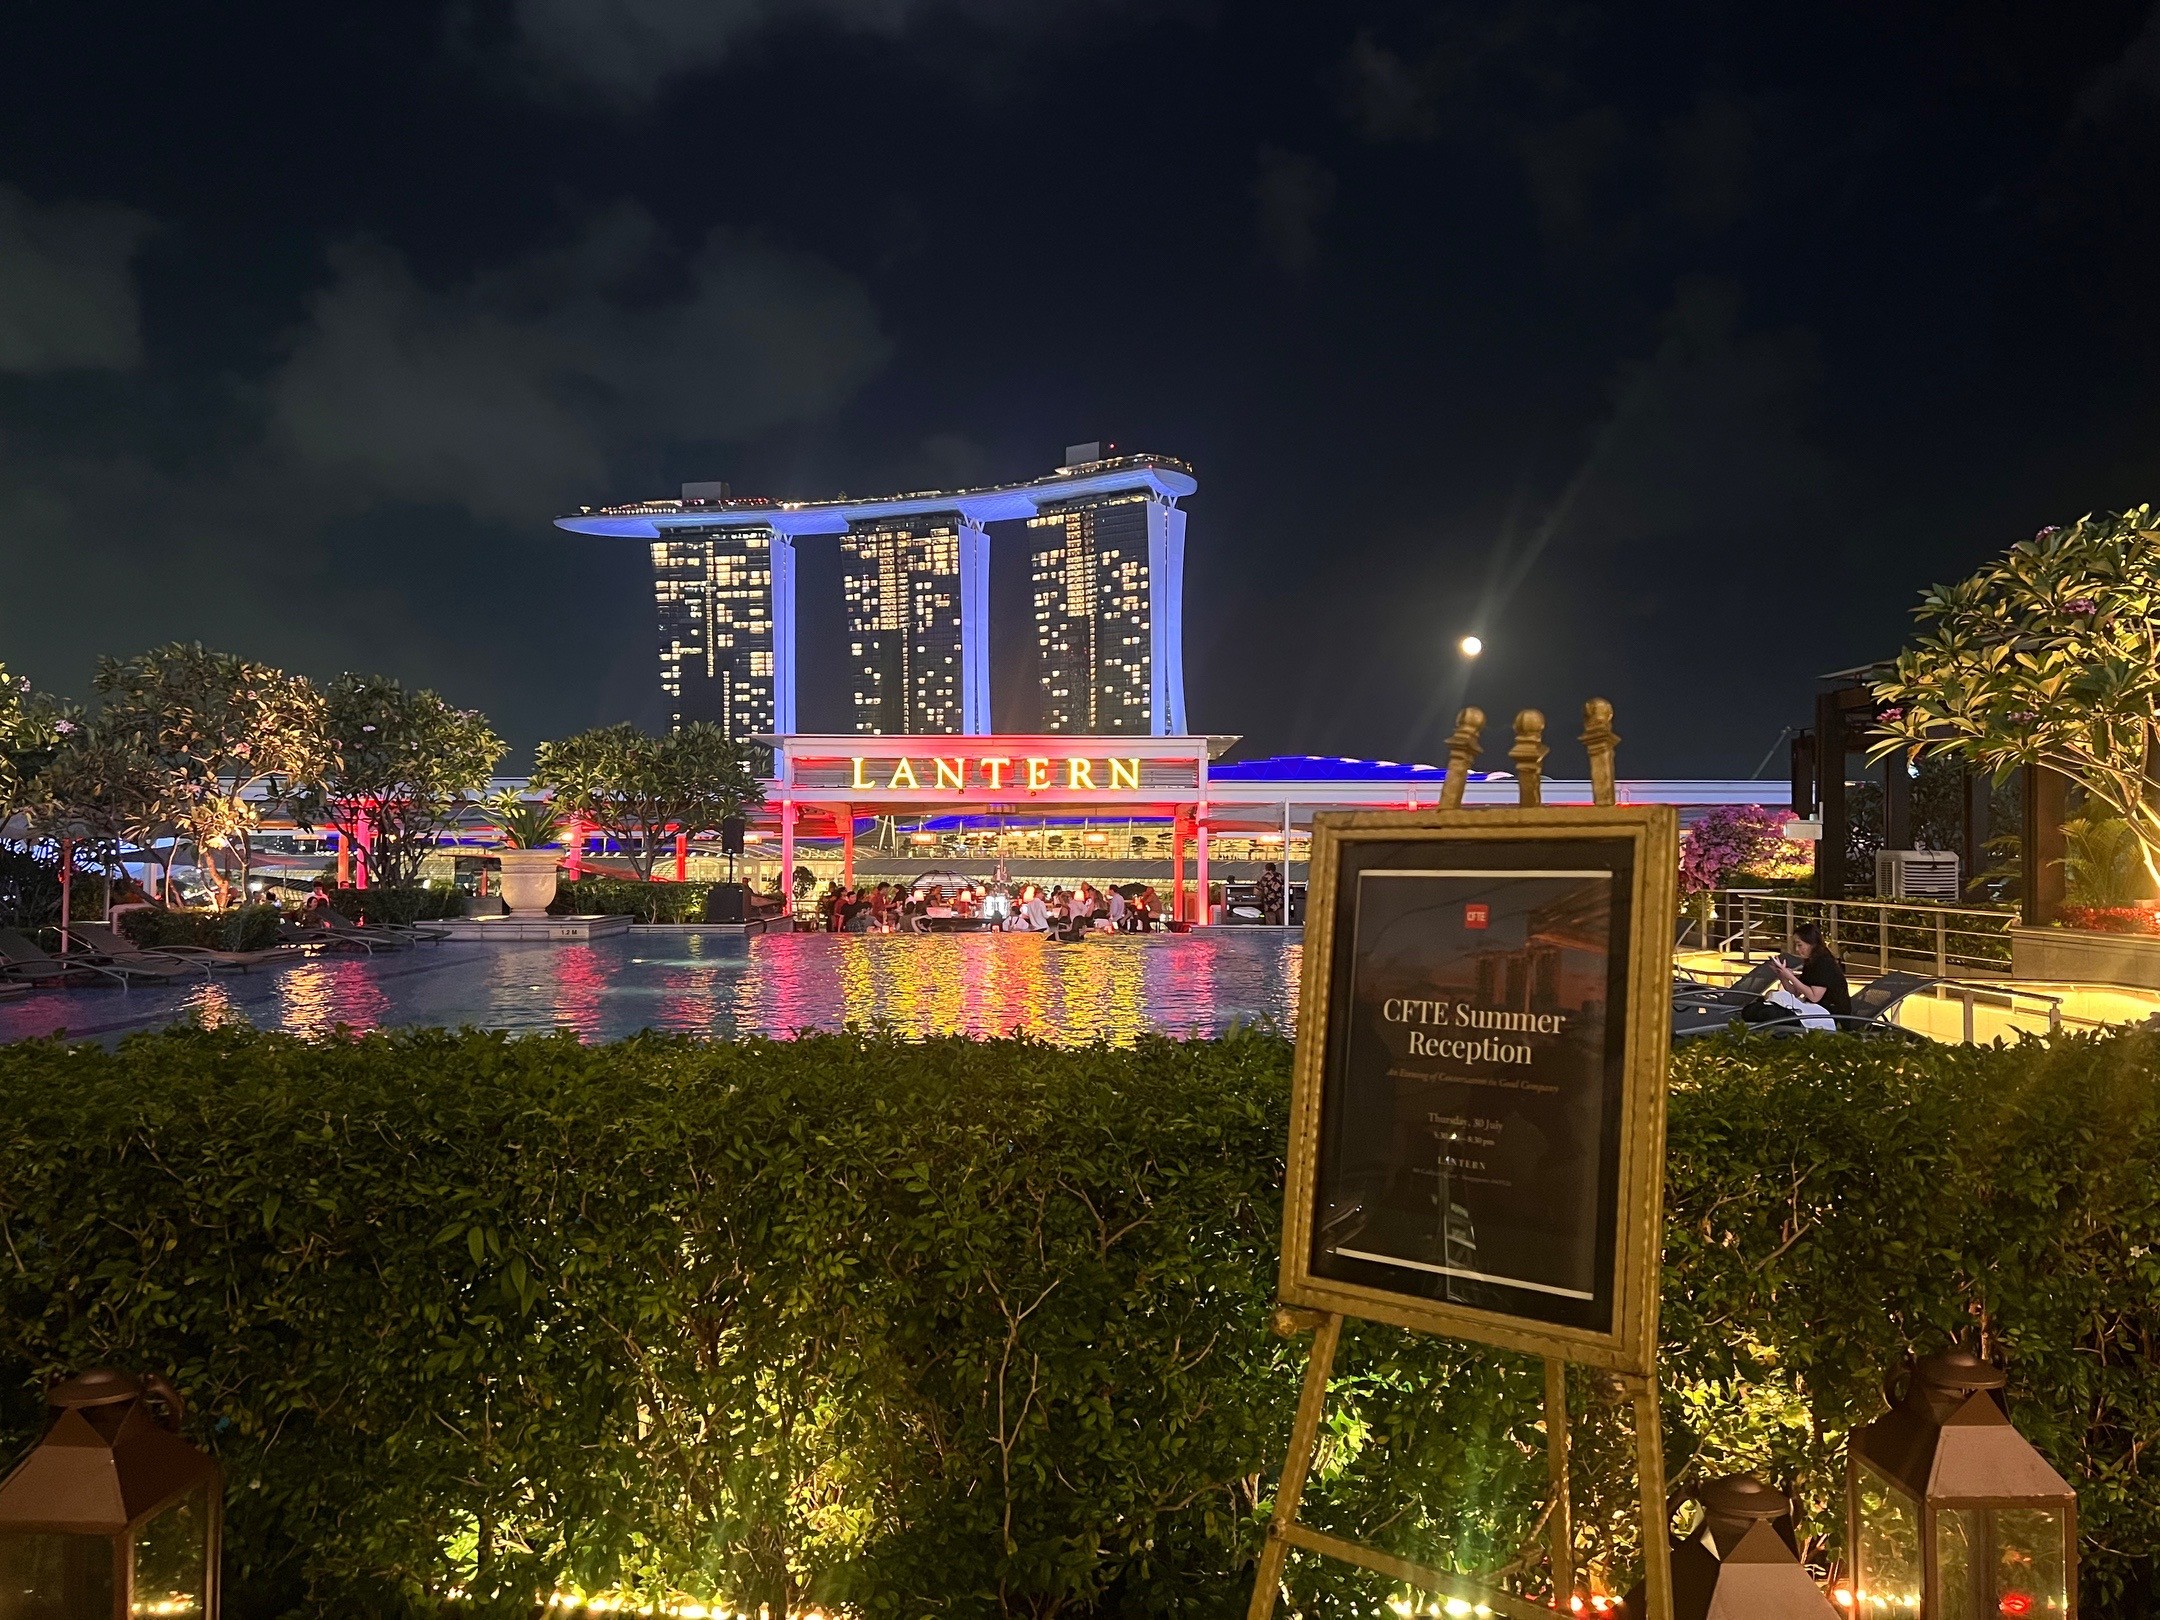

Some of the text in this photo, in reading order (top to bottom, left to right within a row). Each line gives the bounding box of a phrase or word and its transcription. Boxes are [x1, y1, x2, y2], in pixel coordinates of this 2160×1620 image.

[851, 756, 1141, 791] LANTERN
[1466, 911, 1486, 922] CFTE
[1383, 998, 1567, 1034] CFTE Summer
[1408, 1031, 1532, 1065] Reception
[1484, 1119, 1503, 1134] July
